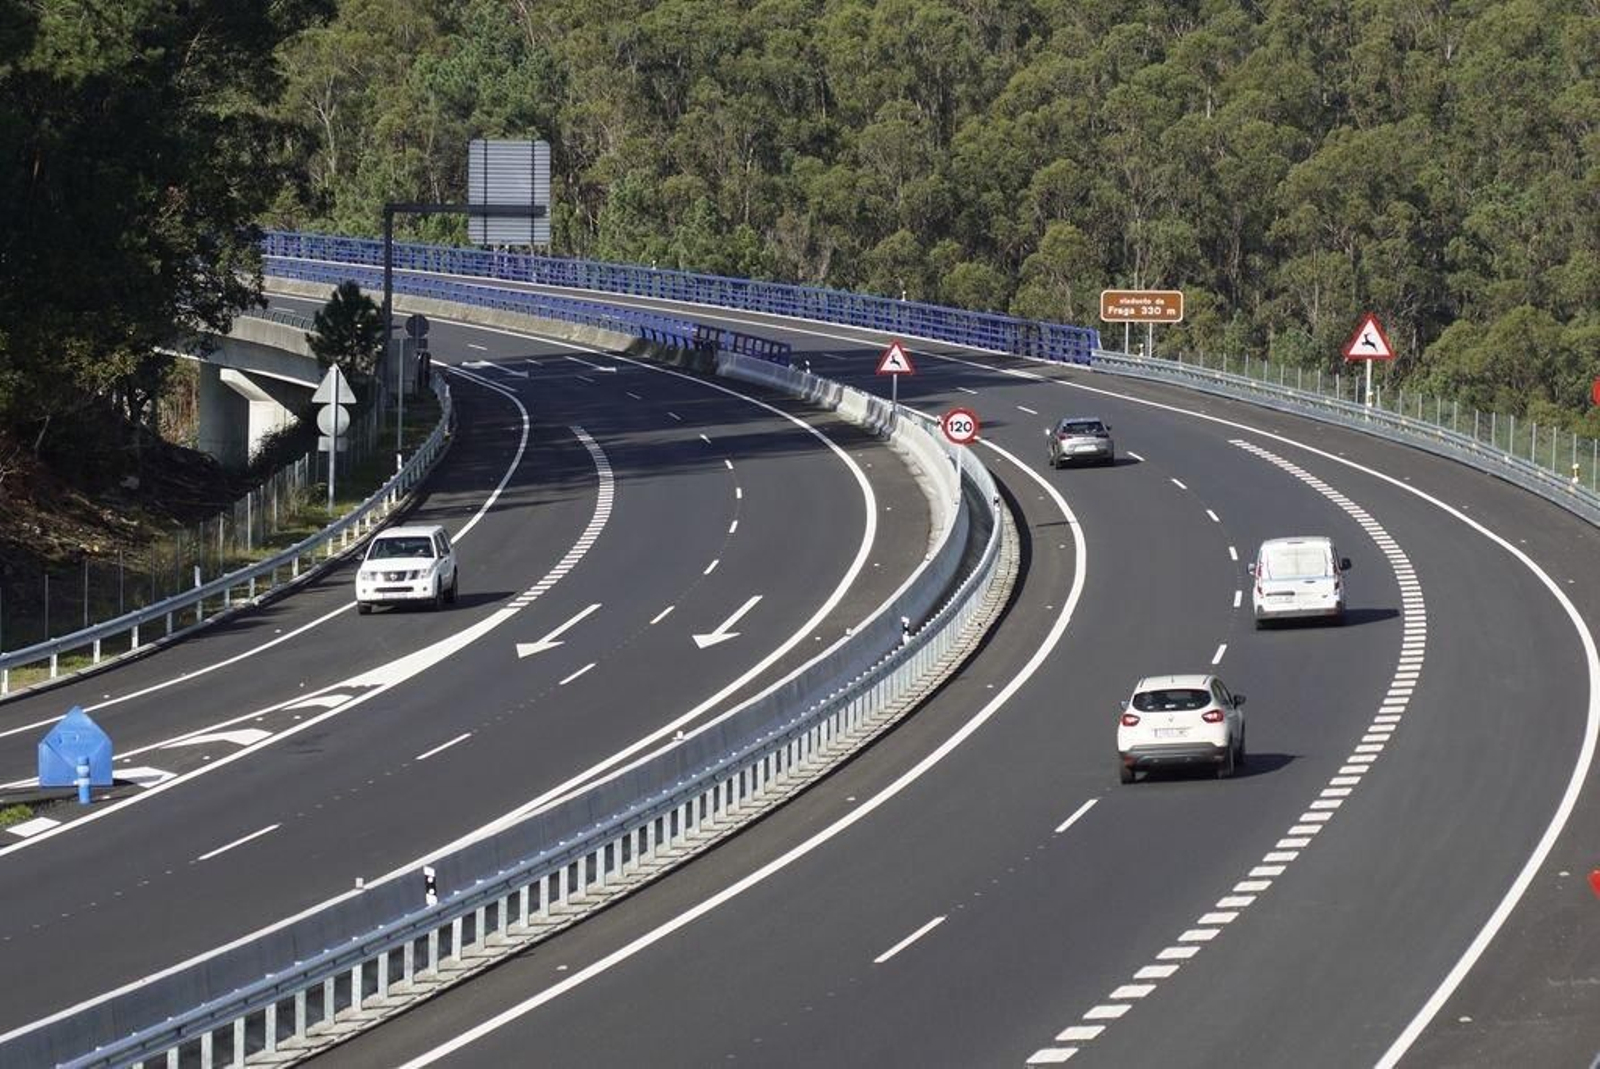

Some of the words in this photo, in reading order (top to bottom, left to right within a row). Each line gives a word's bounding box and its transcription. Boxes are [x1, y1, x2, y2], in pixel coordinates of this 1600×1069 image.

[1108, 306, 1135, 316] Fraga
[1141, 306, 1162, 315] 330
[949, 420, 972, 433] 120
